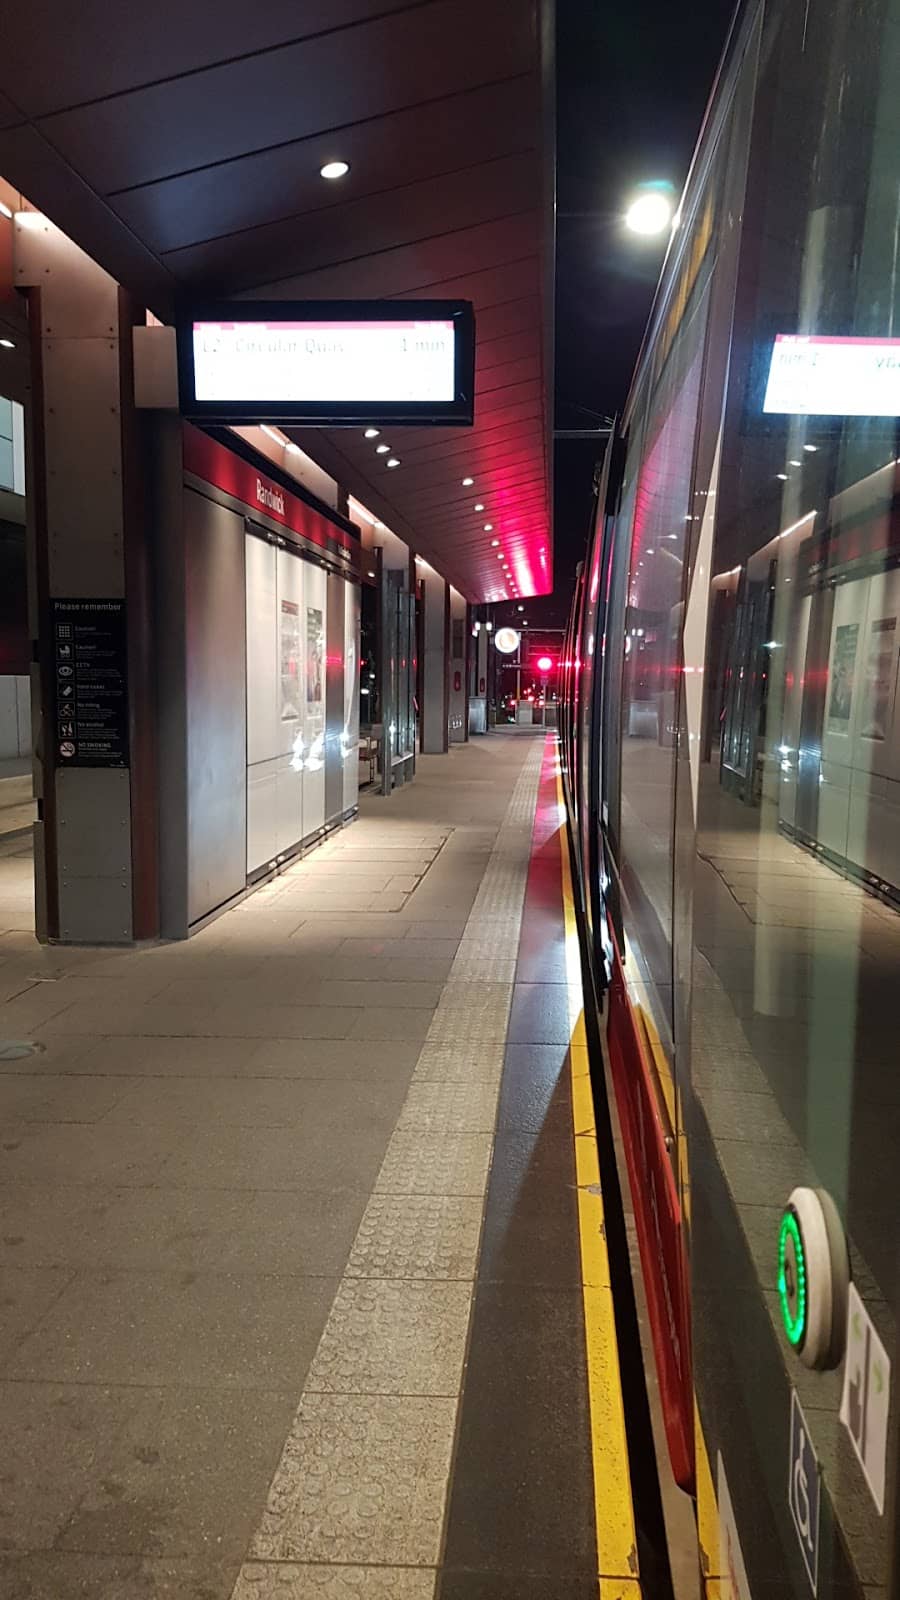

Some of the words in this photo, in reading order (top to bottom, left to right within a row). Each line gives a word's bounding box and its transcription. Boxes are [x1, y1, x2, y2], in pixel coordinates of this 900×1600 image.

[256, 478, 285, 516] Randwick
[54, 602, 80, 610] Please
[81, 602, 121, 610] remember
